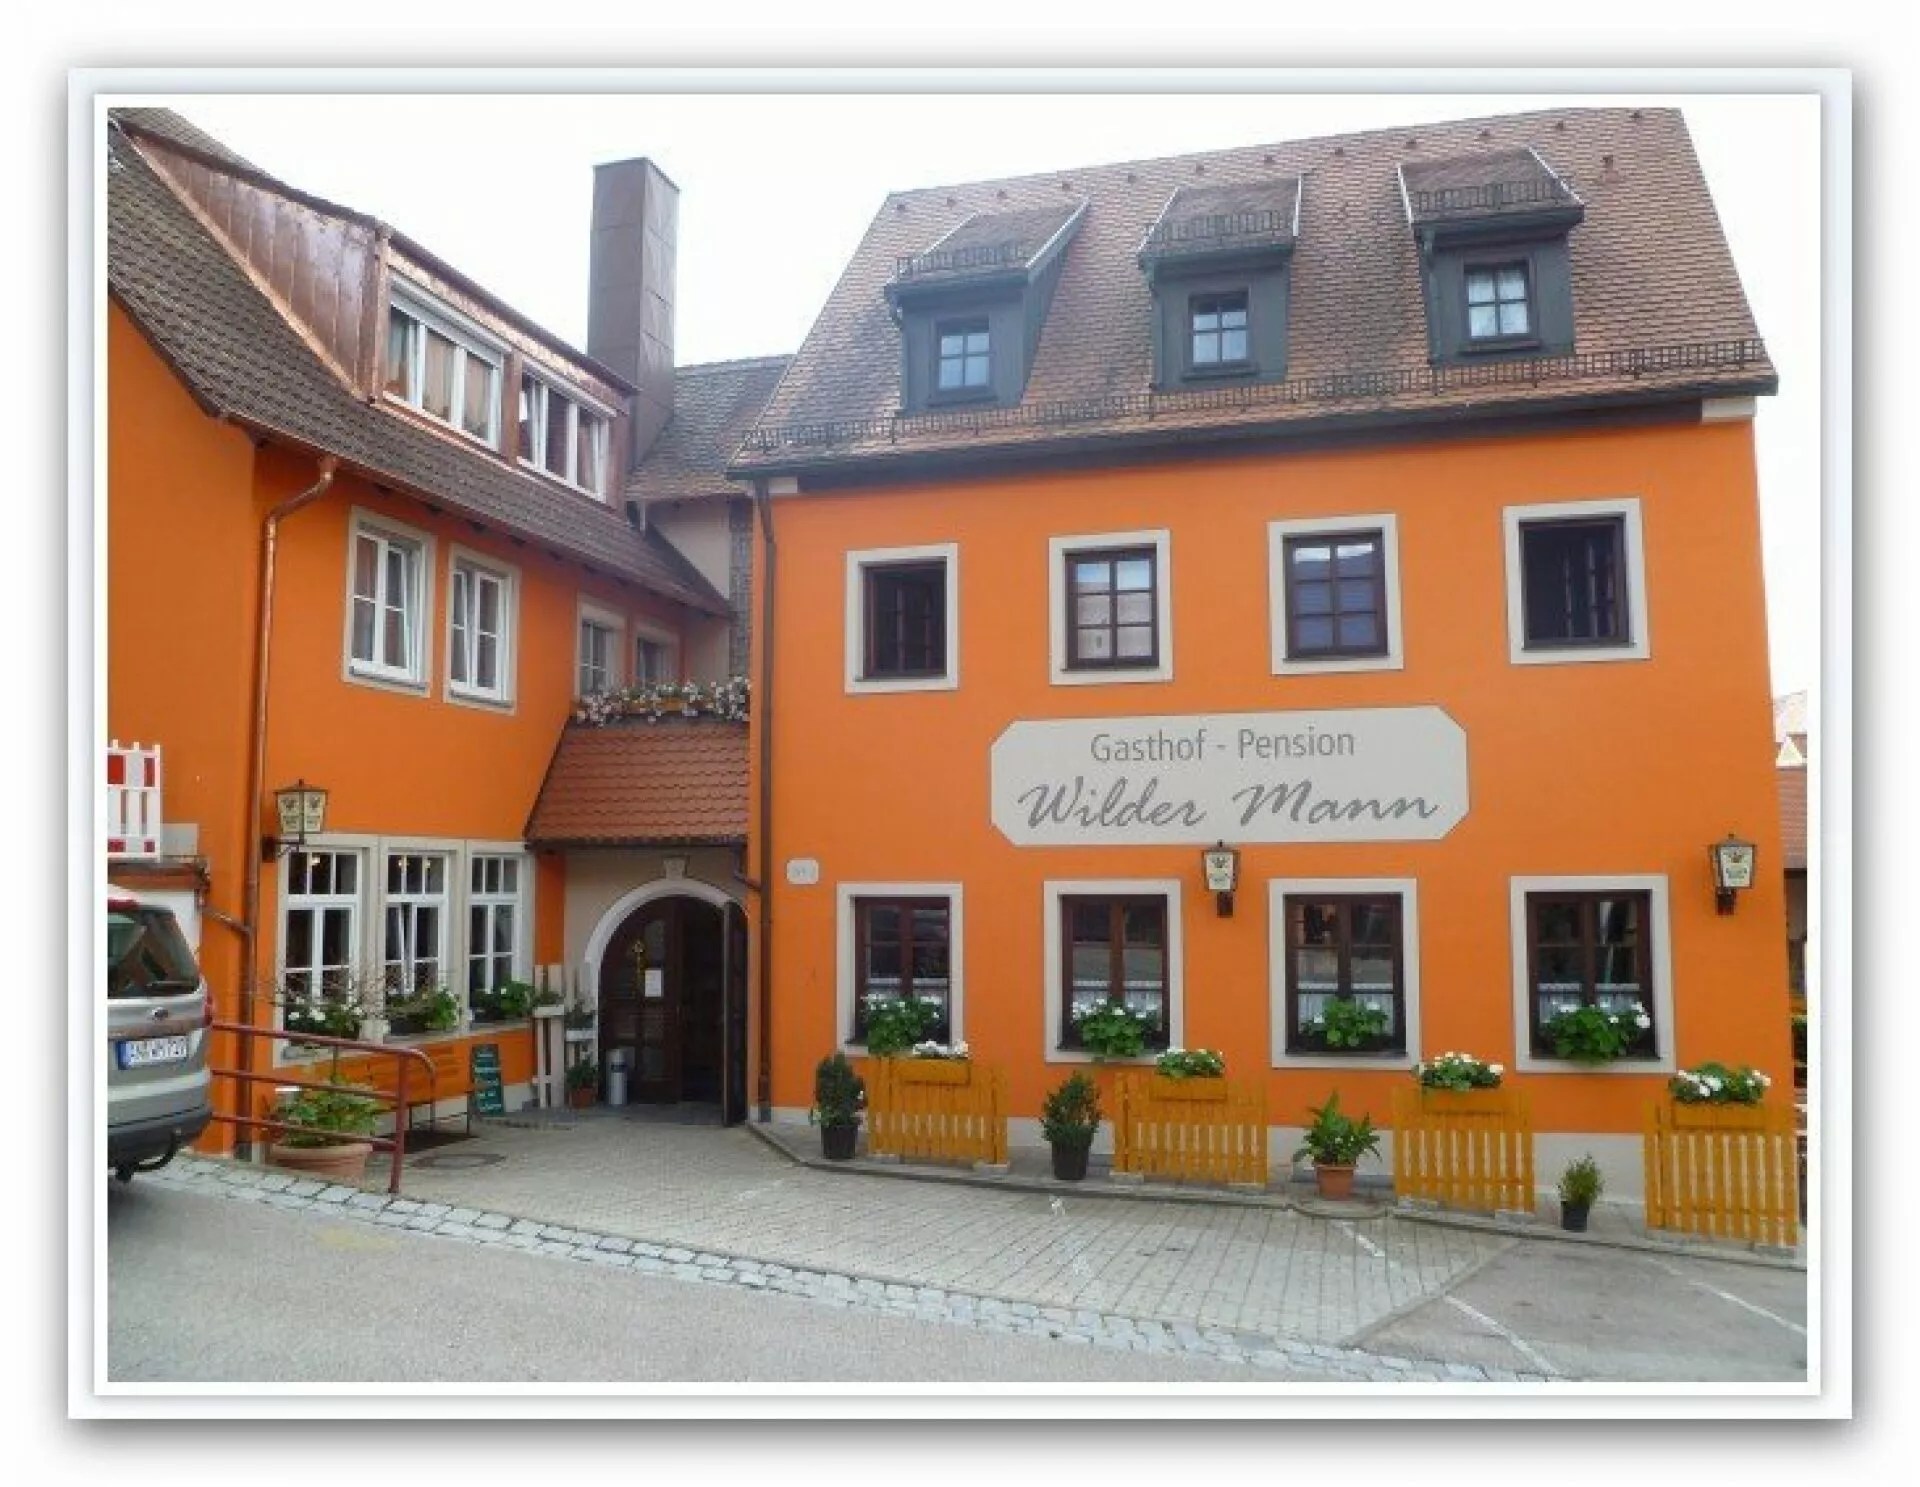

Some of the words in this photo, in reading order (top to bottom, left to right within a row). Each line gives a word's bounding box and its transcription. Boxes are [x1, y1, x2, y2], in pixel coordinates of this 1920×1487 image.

[1090, 728, 1207, 762] Gasthof
[1238, 725, 1354, 760] Pension
[1017, 775, 1207, 829] Wilder
[1232, 779, 1440, 827] Mann
